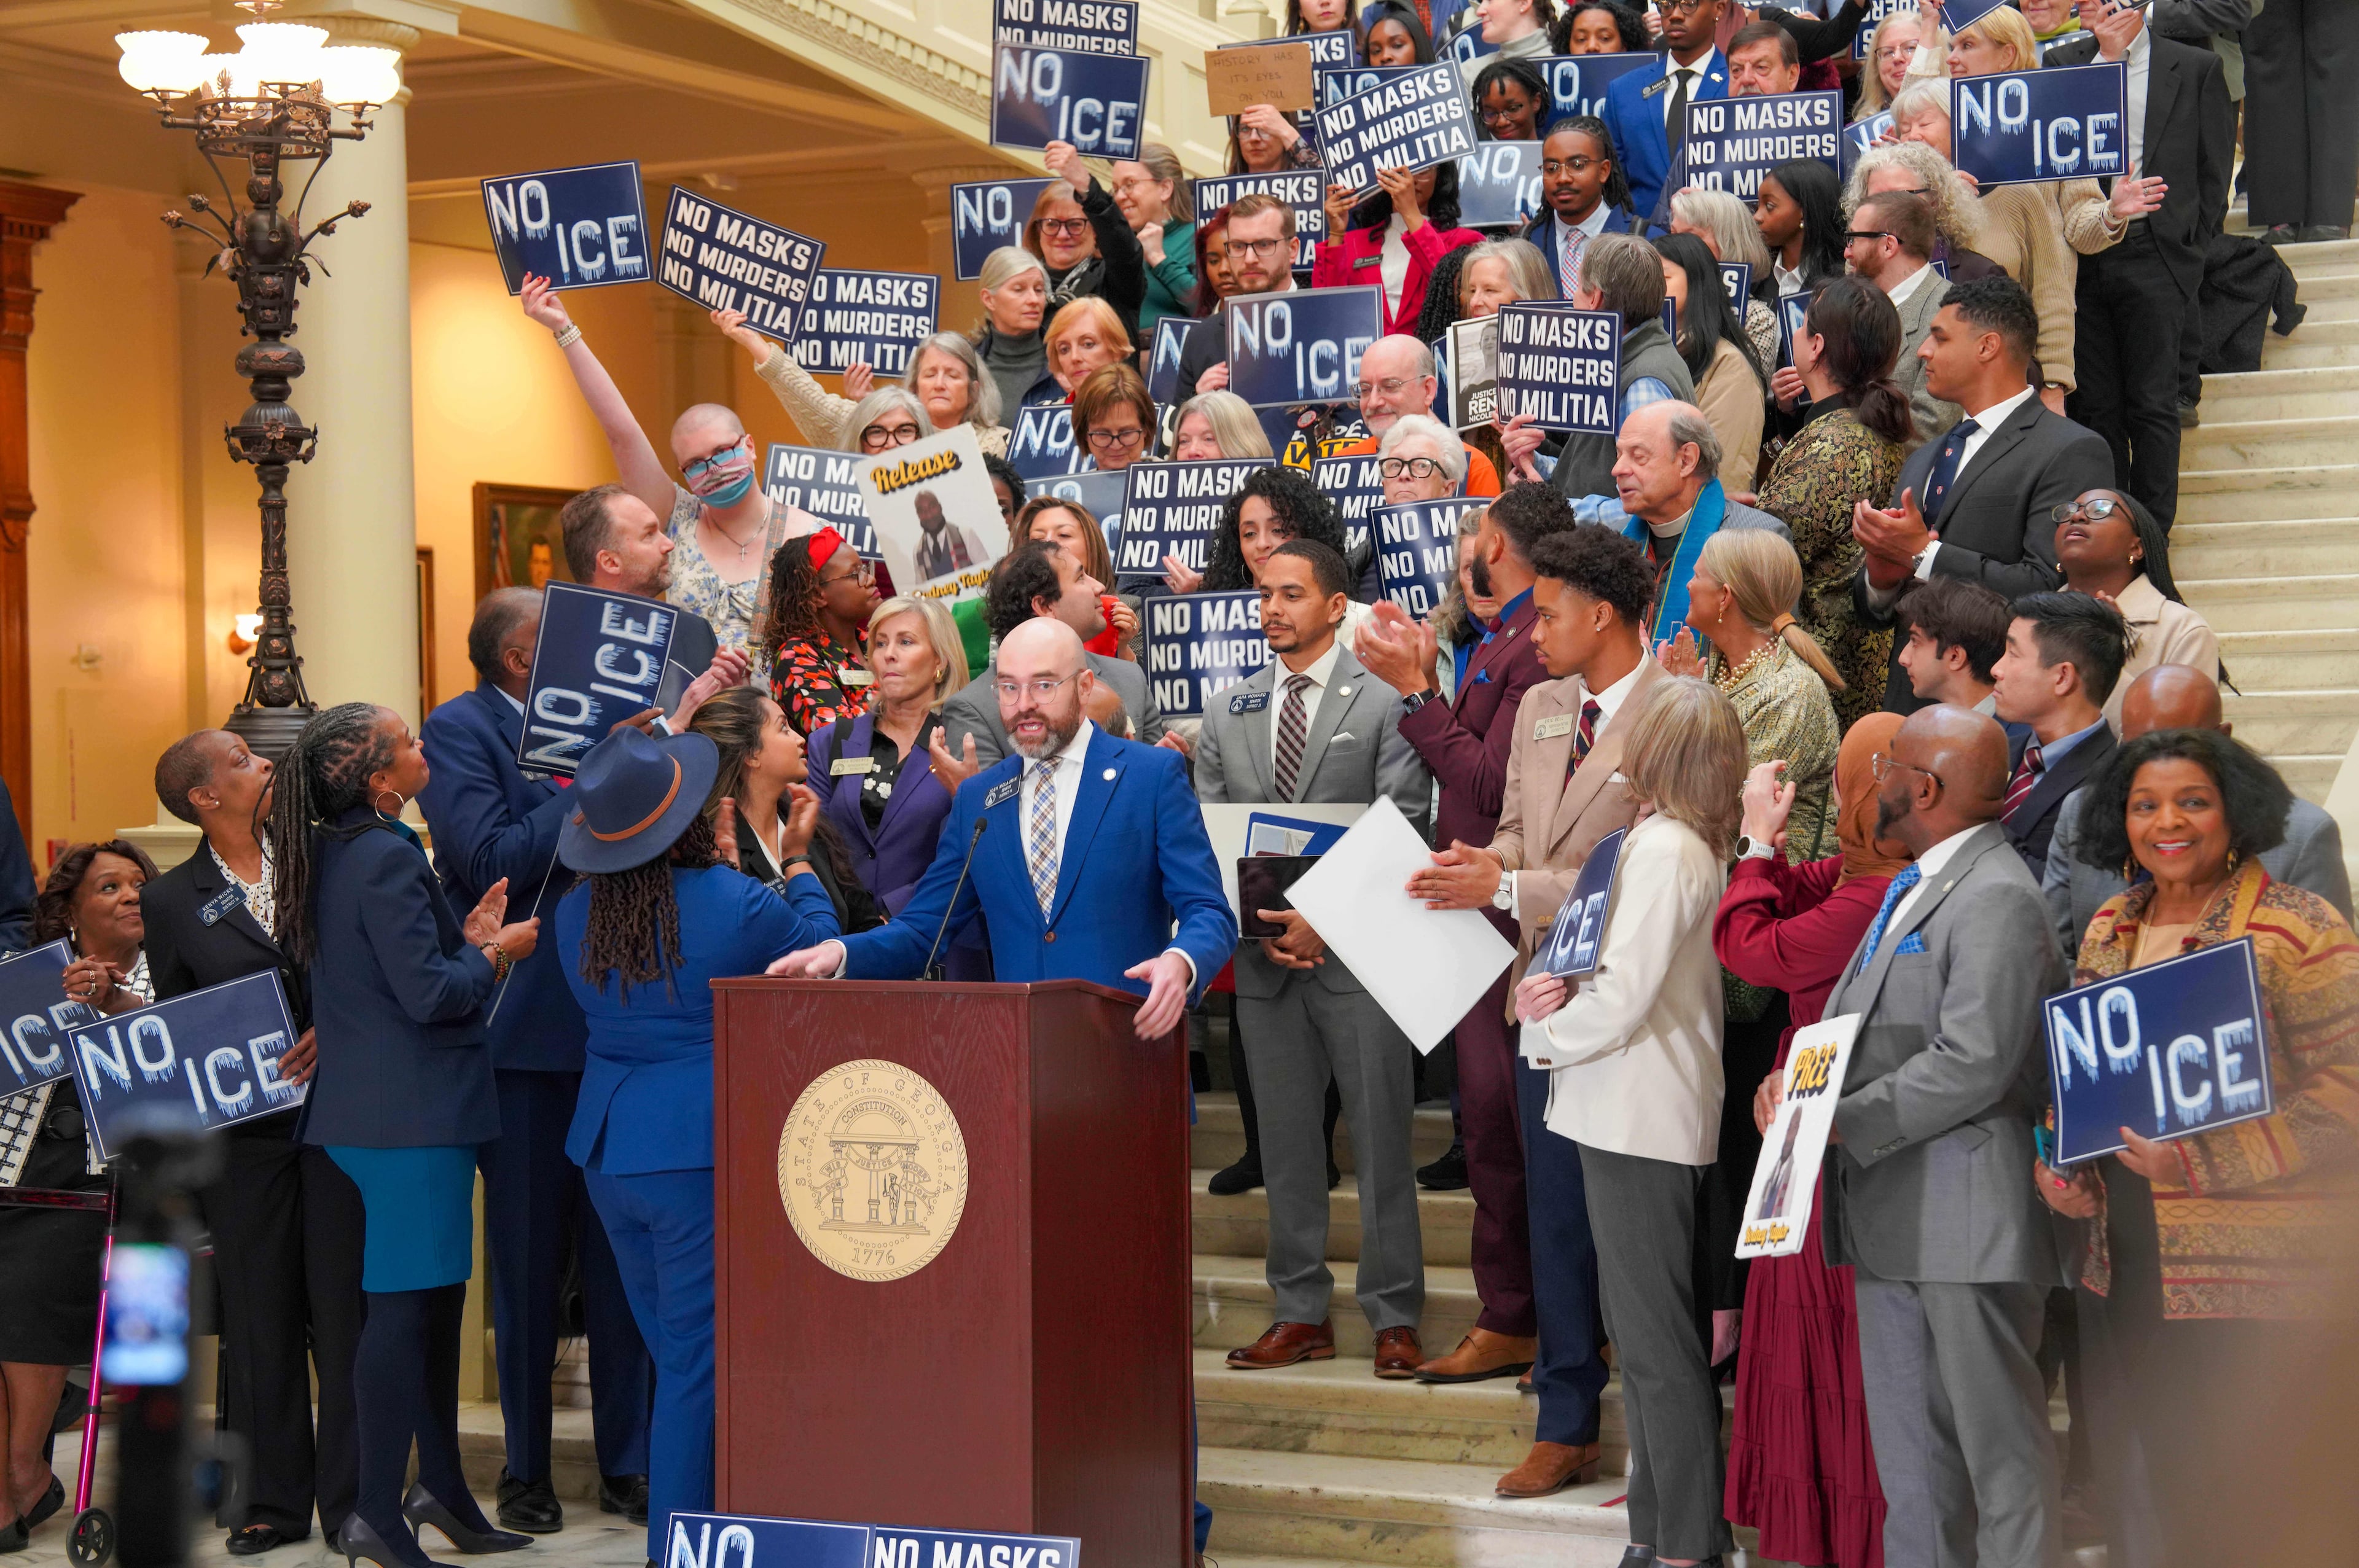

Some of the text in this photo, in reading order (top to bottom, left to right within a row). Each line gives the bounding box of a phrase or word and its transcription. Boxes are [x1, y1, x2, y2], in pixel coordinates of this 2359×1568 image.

[1003, 0, 1128, 31] NO MASKS
[998, 26, 1025, 44] NO
[999, 47, 1063, 107] NO
[1213, 52, 1294, 67] HISTORY HAS
[1256, 71, 1282, 82] EYES
[1239, 90, 1285, 102] ON YOU
[1323, 104, 1356, 139] NO
[1361, 68, 1452, 121] MASKS
[1960, 78, 2029, 141] NO
[1057, 95, 1138, 155] ICE
[1327, 97, 1463, 168] NO MURDERS
[1693, 99, 1830, 135] NO MASKS
[1336, 126, 1469, 190] NO MILITIA
[1688, 141, 1716, 166] NO
[1724, 133, 1836, 162] MURDERS
[2032, 112, 2119, 177] ICE
[1458, 146, 1522, 190] NO
[1690, 171, 1723, 192] NO
[1202, 176, 1318, 211] NO MASKS
[488, 179, 550, 244] NO
[957, 185, 1012, 239] NO
[556, 214, 643, 284] ICE
[676, 197, 812, 271] NO MASKS
[666, 227, 807, 302] NO MURDERS
[664, 256, 791, 335] NO MILITIA
[813, 275, 928, 308] O MASKS
[802, 309, 931, 338] O MURDERS
[1234, 300, 1292, 362] NO
[1503, 313, 1611, 351] NO MASKS
[792, 339, 822, 366] NO
[1296, 336, 1374, 399] ICE
[1499, 352, 1614, 387] NO MURDERS
[1469, 395, 1497, 415] REN
[1471, 388, 1496, 400] JUSTICE
[1501, 387, 1610, 426] NO MILITIA
[1015, 410, 1073, 458] NO
[778, 452, 816, 480] NO
[870, 449, 961, 494] Release
[1317, 462, 1352, 490] NO
[769, 484, 801, 509] NO
[1135, 469, 1169, 499] NO
[1126, 504, 1224, 532] NO MURD
[1380, 511, 1420, 544] NO
[1122, 540, 1160, 568] NO
[1382, 551, 1415, 579] NO
[1154, 598, 1261, 636] NO MAS
[1390, 585, 1429, 614] NO
[590, 601, 670, 706] ICE
[1151, 638, 1277, 673] NO MURDE
[1154, 678, 1189, 711] NO
[525, 687, 603, 769] NO
[999, 776, 1017, 790] MCLAURIN
[202, 887, 233, 911] KENYA WICKS
[221, 894, 234, 905] SENATOR
[222, 899, 235, 911] DISTRICT
[1544, 891, 1605, 972] ICE
[2052, 986, 2142, 1092] NO
[77, 1015, 177, 1102] NO
[1788, 1042, 1837, 1101] FREE
[2147, 1018, 2261, 1134] ICE
[184, 1030, 298, 1126] ICE
[842, 1101, 907, 1126] CONSTITUTION
[794, 1072, 955, 1193] STATE OF GEORGIA
[824, 1160, 841, 1172] WIS
[856, 1158, 893, 1169] JUSTICE
[902, 1162, 928, 1180] MODER
[825, 1179, 842, 1192] DOM
[902, 1182, 928, 1200] ATION
[851, 1247, 895, 1265] 1776
[673, 1520, 754, 1568] NO
[877, 1537, 1060, 1568] NO MASKS
